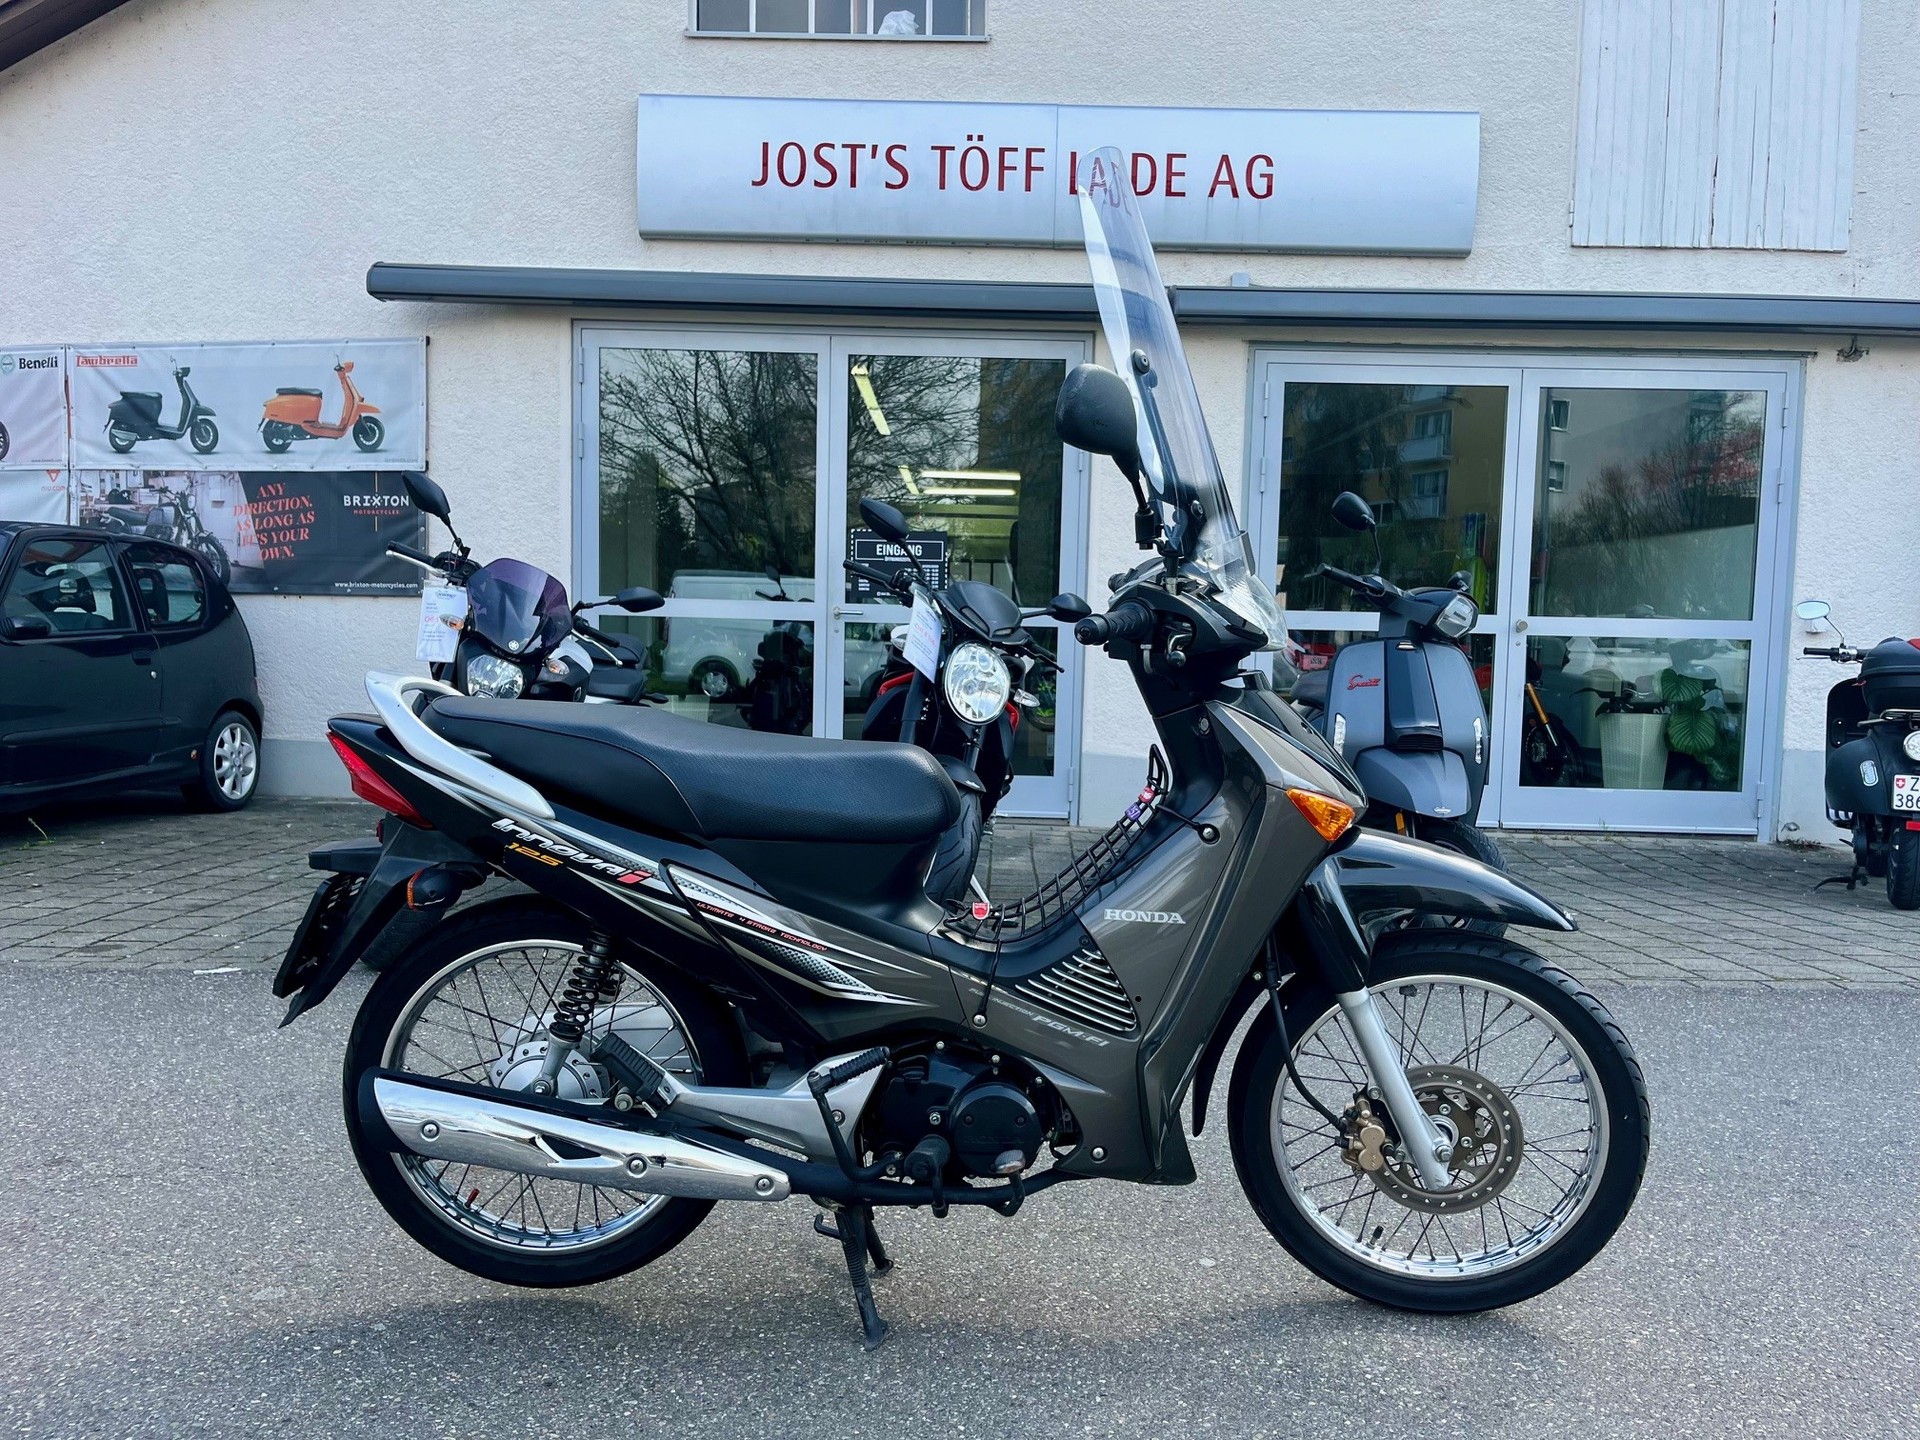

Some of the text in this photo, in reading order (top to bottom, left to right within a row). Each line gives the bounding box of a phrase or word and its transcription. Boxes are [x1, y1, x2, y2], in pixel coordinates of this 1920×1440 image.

[751, 141, 909, 190] JOST'S
[931, 134, 1045, 192] TÖFF
[1208, 153, 1275, 199] AG
[19, 356, 58, 369] Benelli
[76, 355, 138, 367] Lambretta
[257, 483, 285, 498] ANY
[233, 496, 313, 516] DIRECTION.
[343, 495, 409, 507] BRIXTON
[237, 511, 315, 531] AS LONG AS
[271, 527, 309, 544] YOUR
[259, 545, 294, 560] OWN.
[876, 543, 923, 556] EINGANG
[334, 581, 418, 590] www.brixton-motorcycles.com
[508, 842, 564, 867] 125
[1104, 908, 1186, 924] HONDA
[696, 902, 735, 918] ULTIMATE
[746, 920, 777, 934] STROKE
[780, 931, 828, 951] TECHNOLOGY
[992, 997, 1034, 1016] INJECTION
